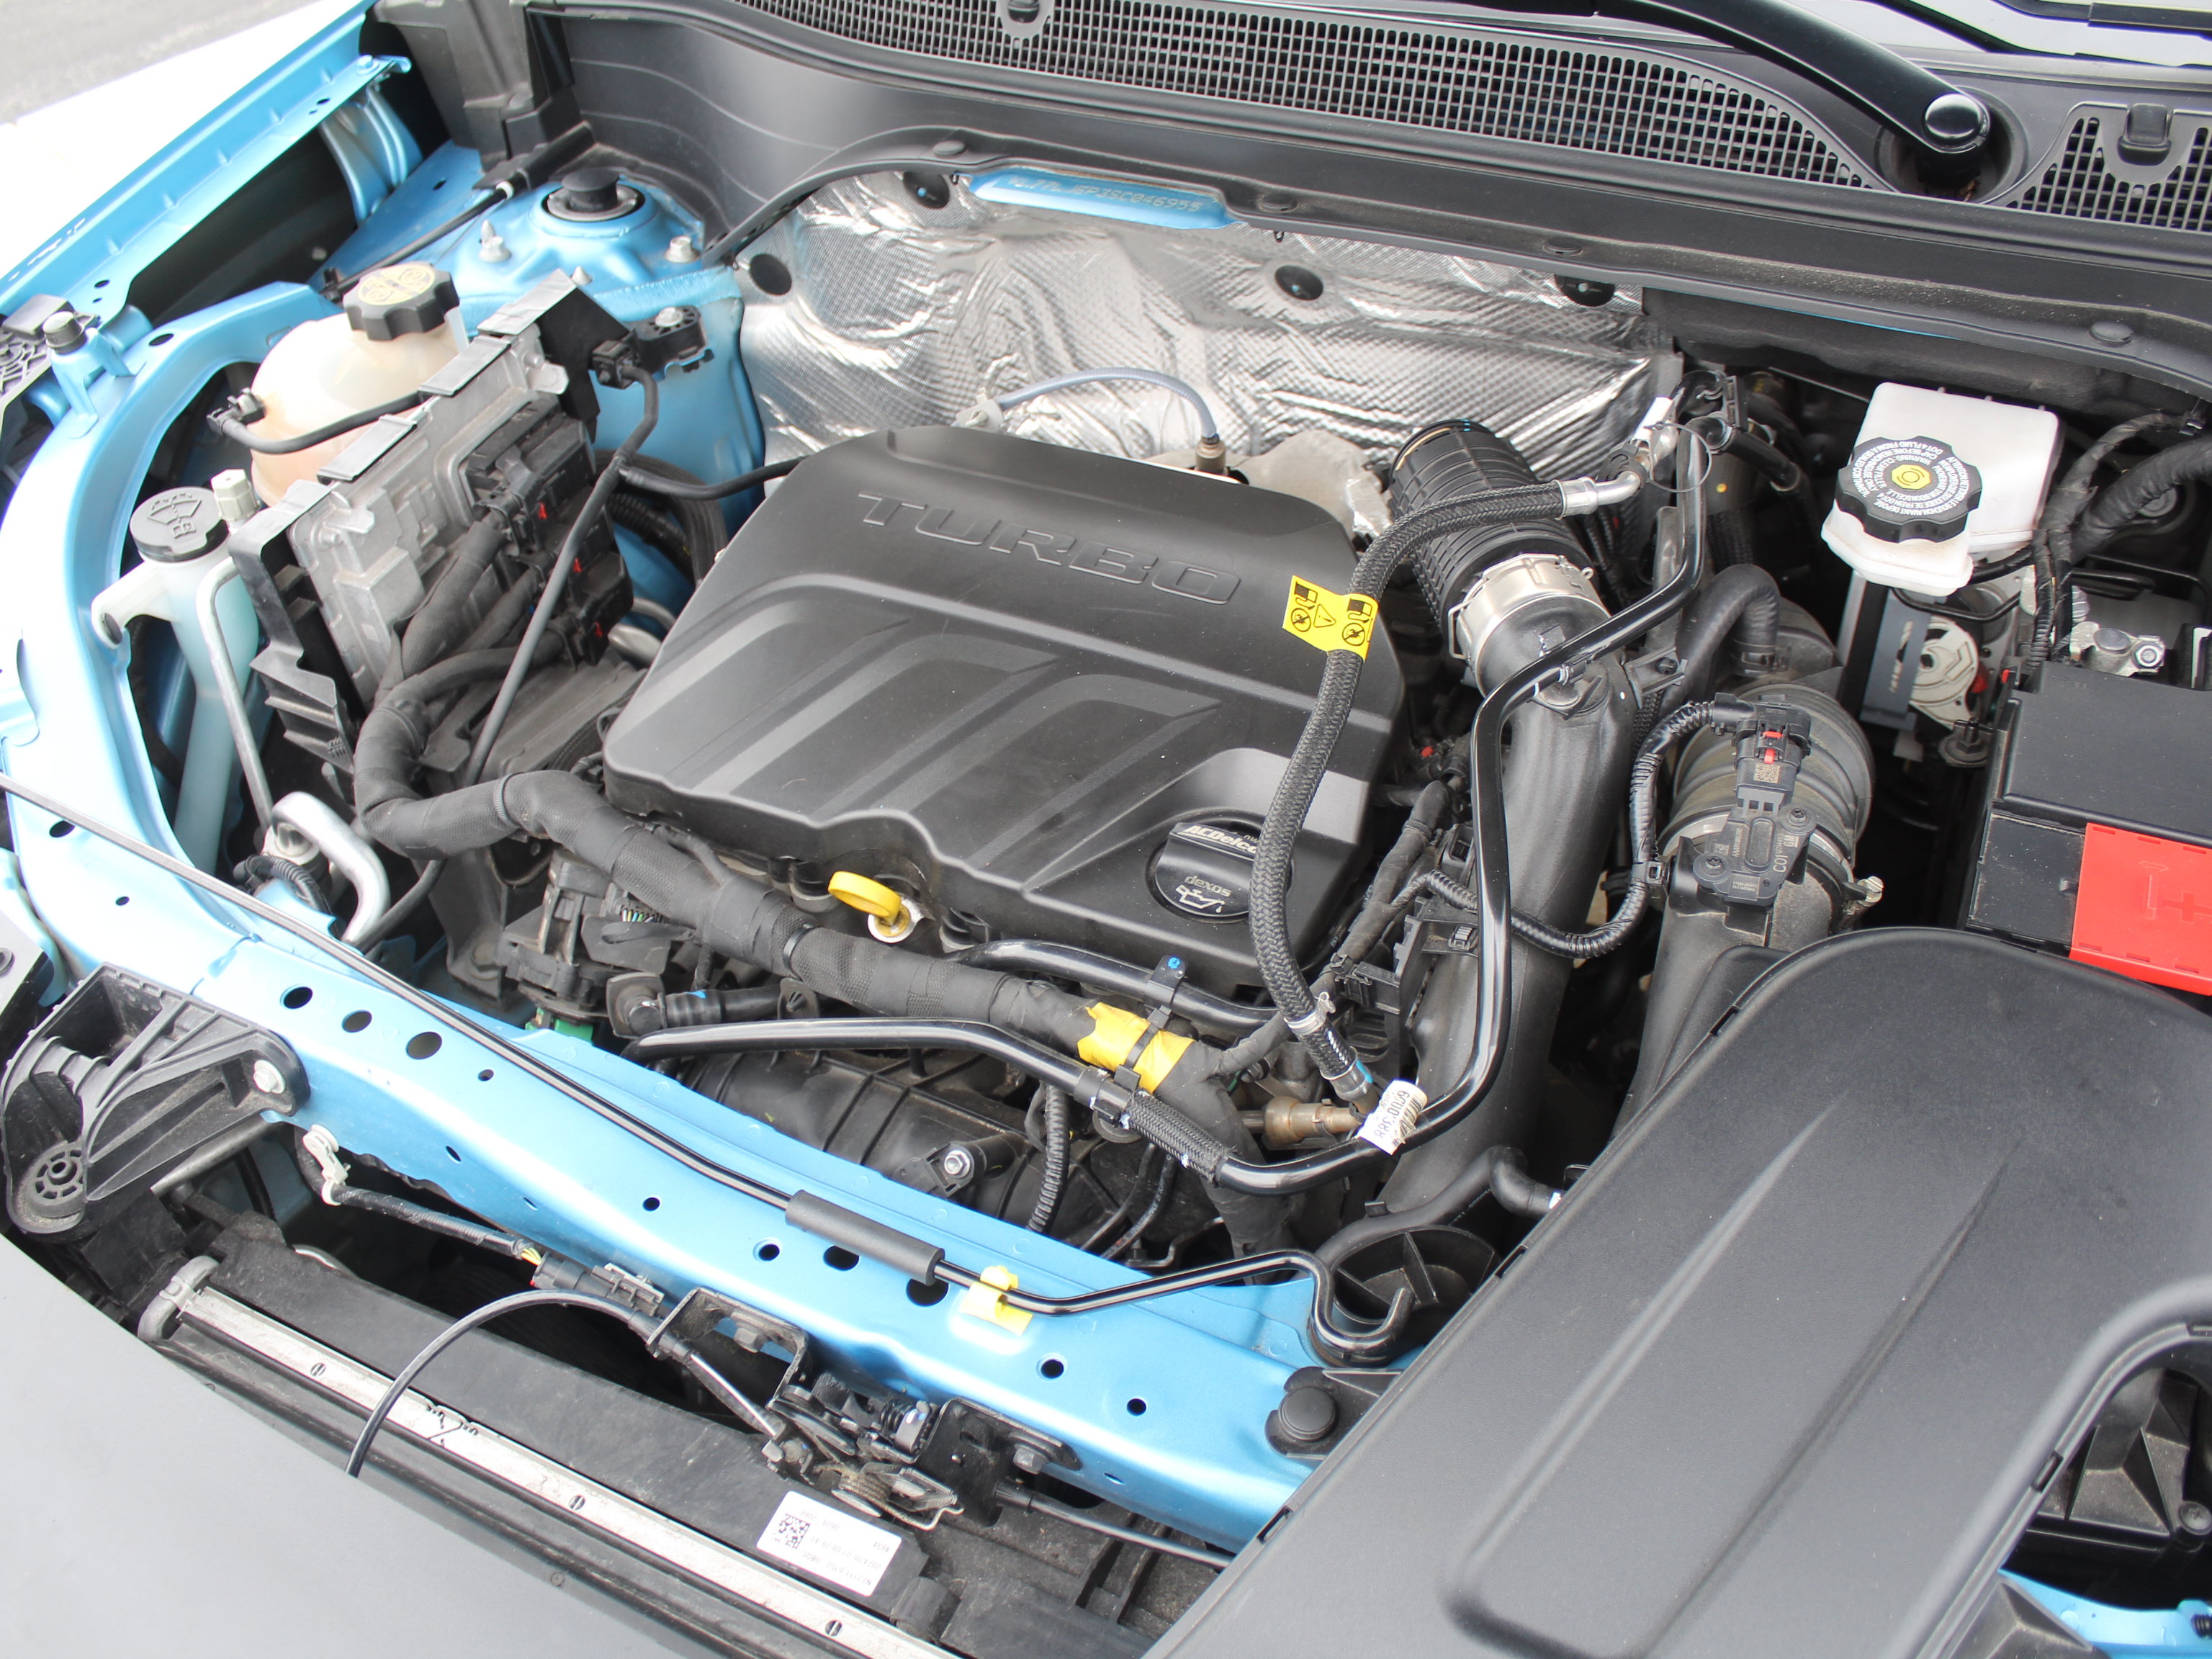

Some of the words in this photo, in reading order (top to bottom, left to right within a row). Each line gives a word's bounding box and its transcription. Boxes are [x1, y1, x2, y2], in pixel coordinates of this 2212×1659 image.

[1875, 441, 1898, 452] FROM
[1925, 444, 1944, 455] DOT
[1853, 449, 1876, 467] SEALED
[1920, 450, 1938, 460] CAP
[1874, 457, 1896, 472] CLEAN
[1863, 479, 1879, 493] ONLY
[1873, 470, 1887, 489] FILLER
[1880, 495, 1895, 504] DOT
[1921, 502, 1953, 516] BOUCHON
[857, 491, 1242, 605] TURBO
[1183, 824, 1258, 854] ACDelco
[1783, 835, 1795, 848] GM
[1184, 876, 1232, 897] dexos
